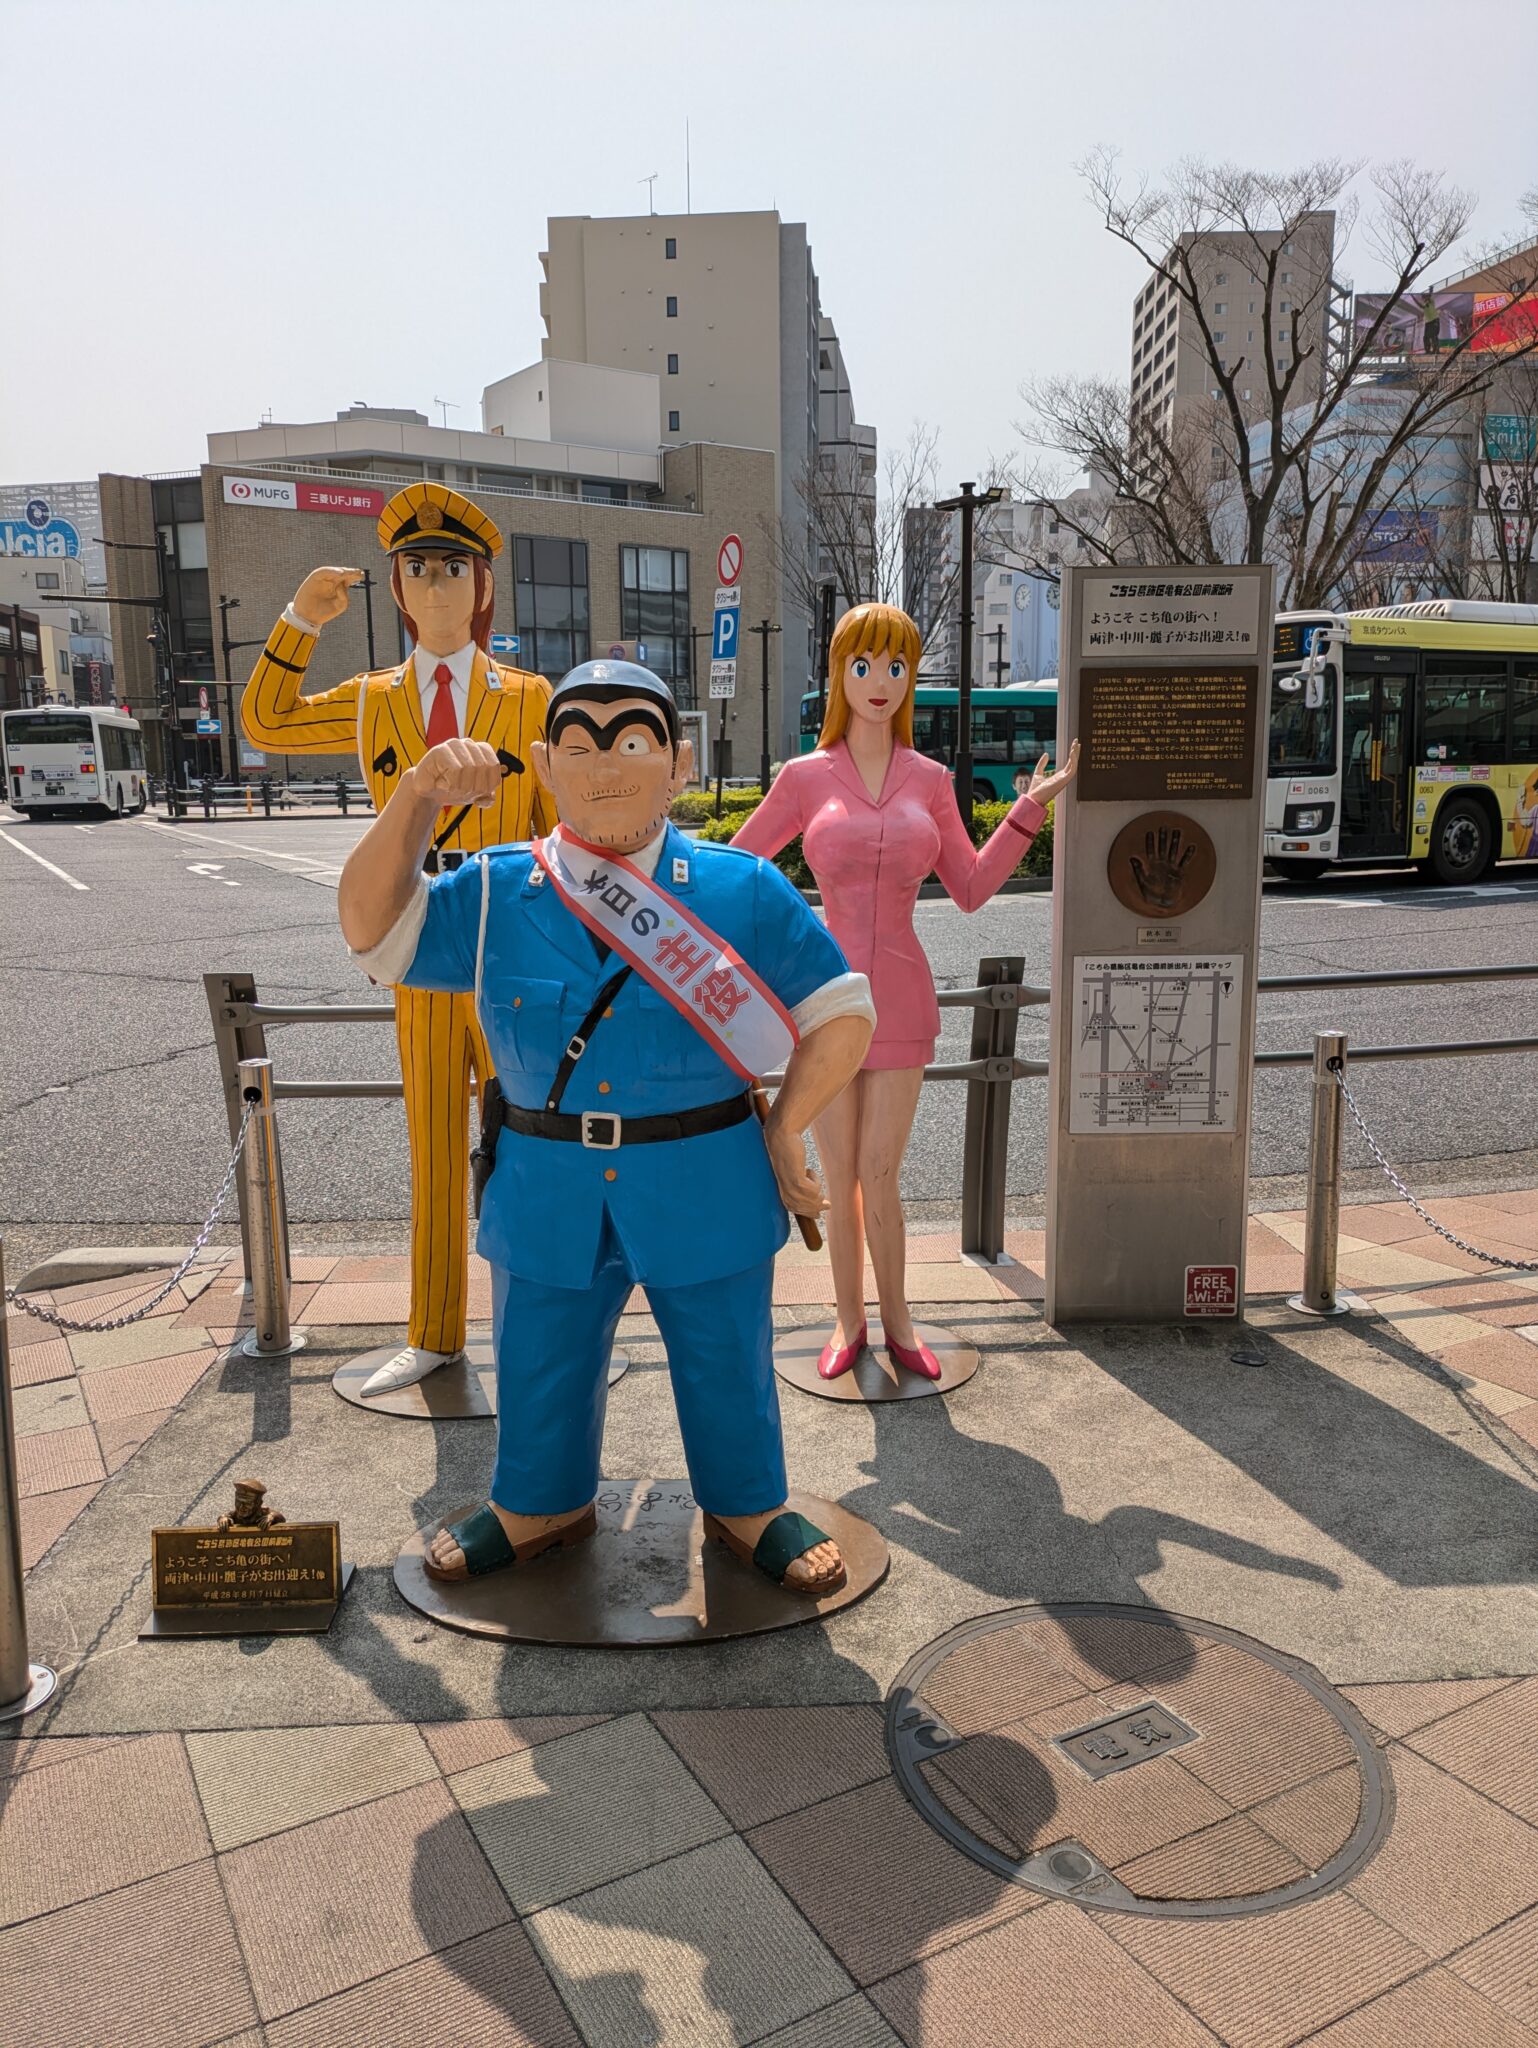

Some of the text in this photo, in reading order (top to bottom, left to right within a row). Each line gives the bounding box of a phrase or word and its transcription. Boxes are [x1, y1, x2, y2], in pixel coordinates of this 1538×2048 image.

[254, 487, 290, 500] MUFG
[309, 492, 372, 508] 三菱UFJ銀行
[1109, 583, 1234, 598] こちら葛飾区亀有公園前派出所
[1090, 610, 1218, 625] ようこそ こち亀の街へ！
[718, 613, 735, 654] P
[1363, 626, 1407, 635] 京成タウンバス
[712, 685, 733, 695] ここから
[1424, 769, 1436, 777] 入口
[1308, 786, 1329, 795] 0063
[1193, 1276, 1228, 1289] FREE
[1193, 1289, 1227, 1303] Wi-Fi
[164, 1552, 291, 1569] ようこそ こち亀の街へ！
[1081, 1718, 1172, 1761] 電気
